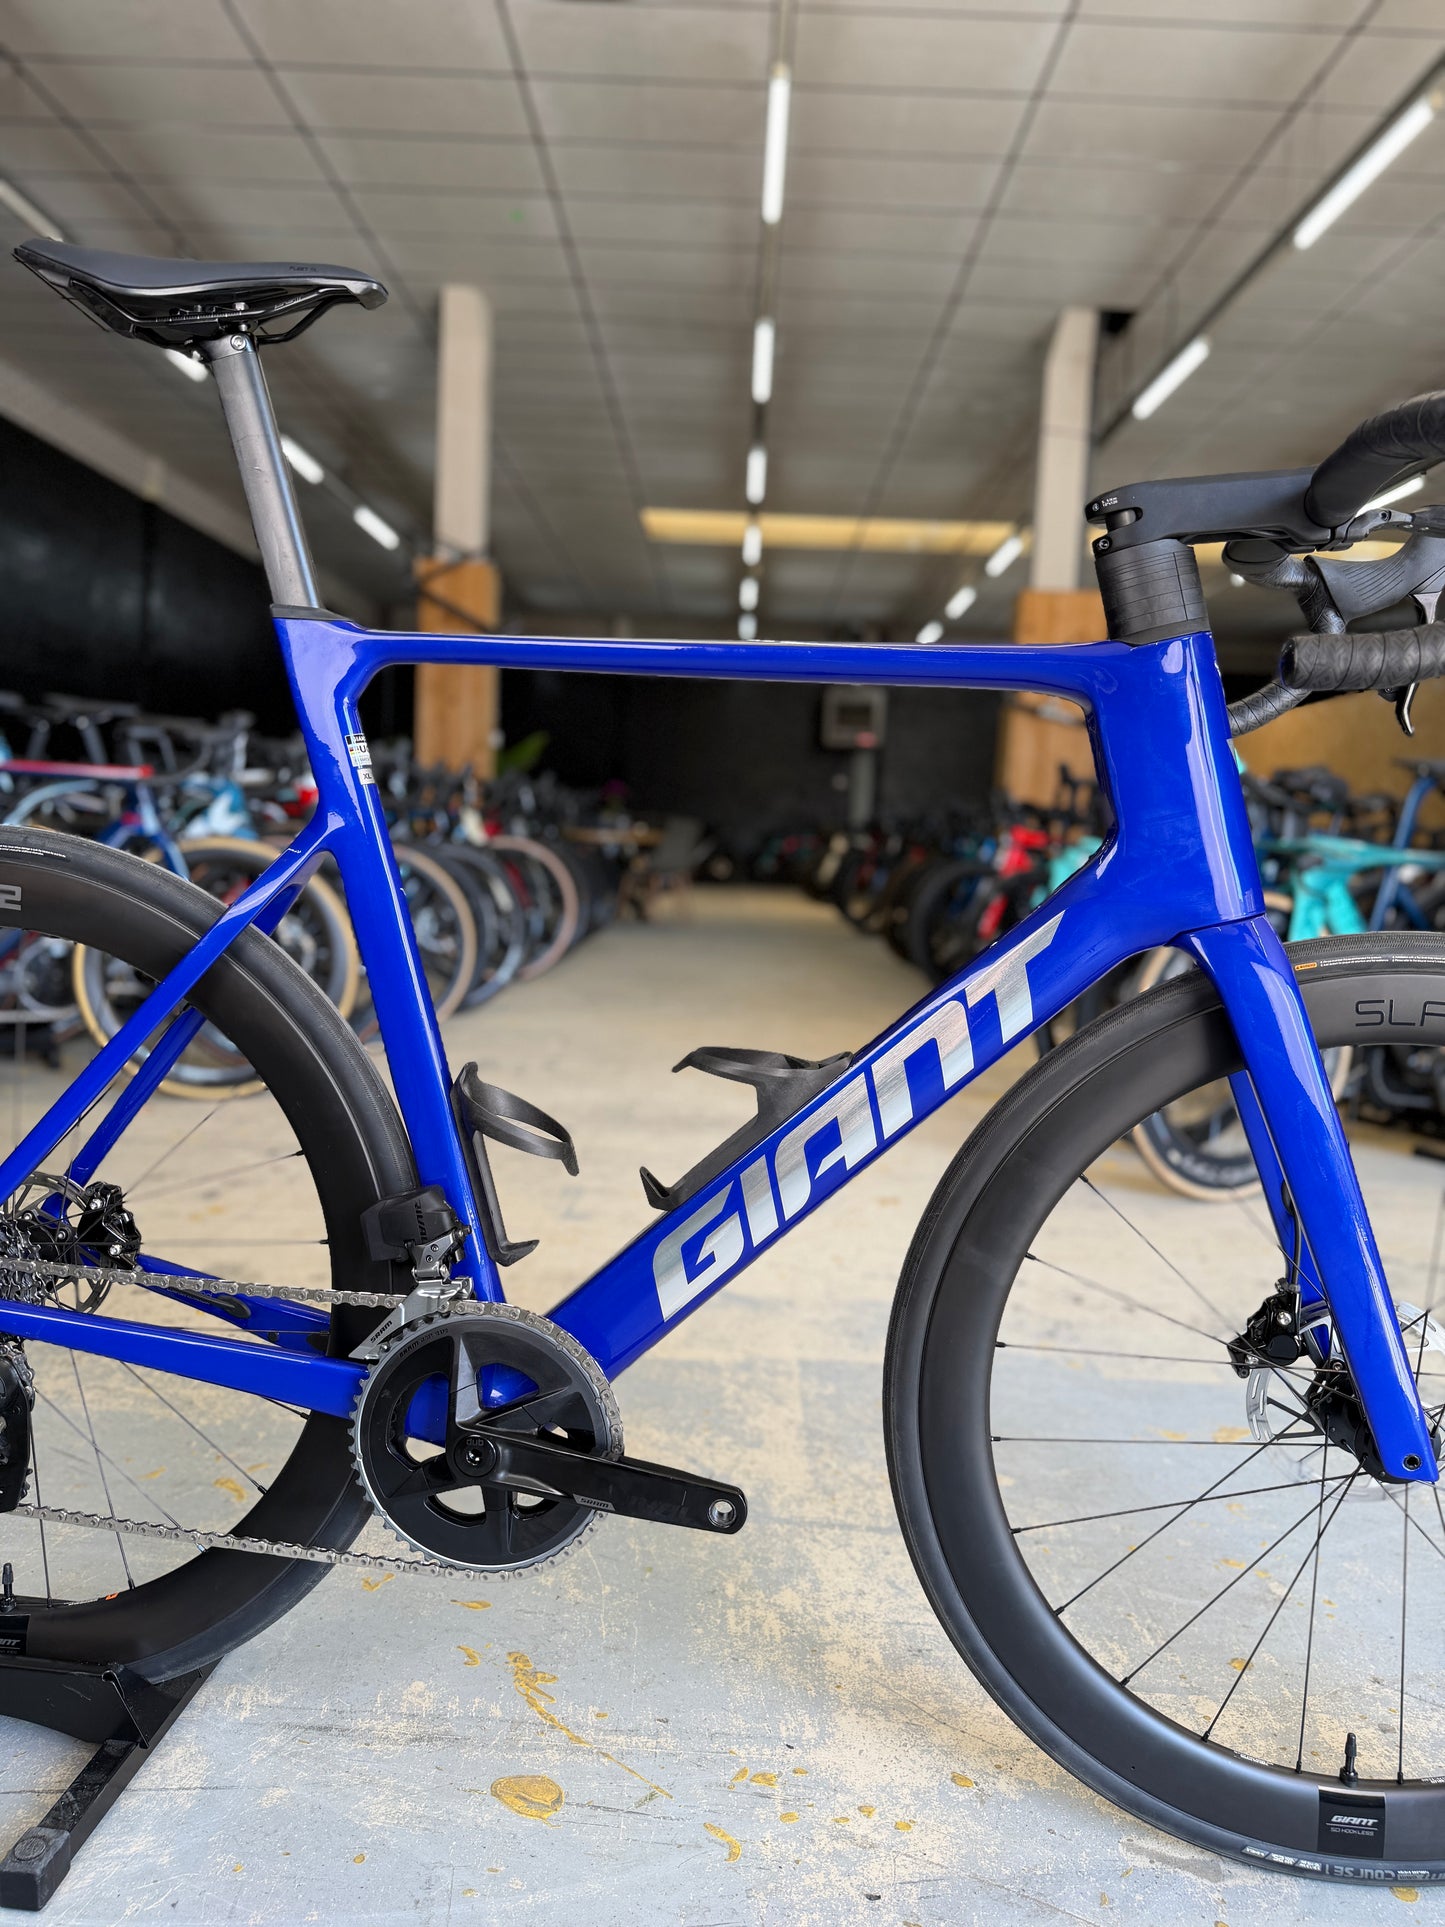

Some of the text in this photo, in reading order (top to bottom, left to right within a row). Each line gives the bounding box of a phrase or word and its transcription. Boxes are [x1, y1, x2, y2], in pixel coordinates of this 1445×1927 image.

[362, 772, 373, 780] XL
[652, 911, 1065, 1322] GIANT
[370, 1320, 393, 1343] SRAM
[580, 1497, 609, 1509] SRAM
[1331, 1815, 1379, 1826] GIANT
